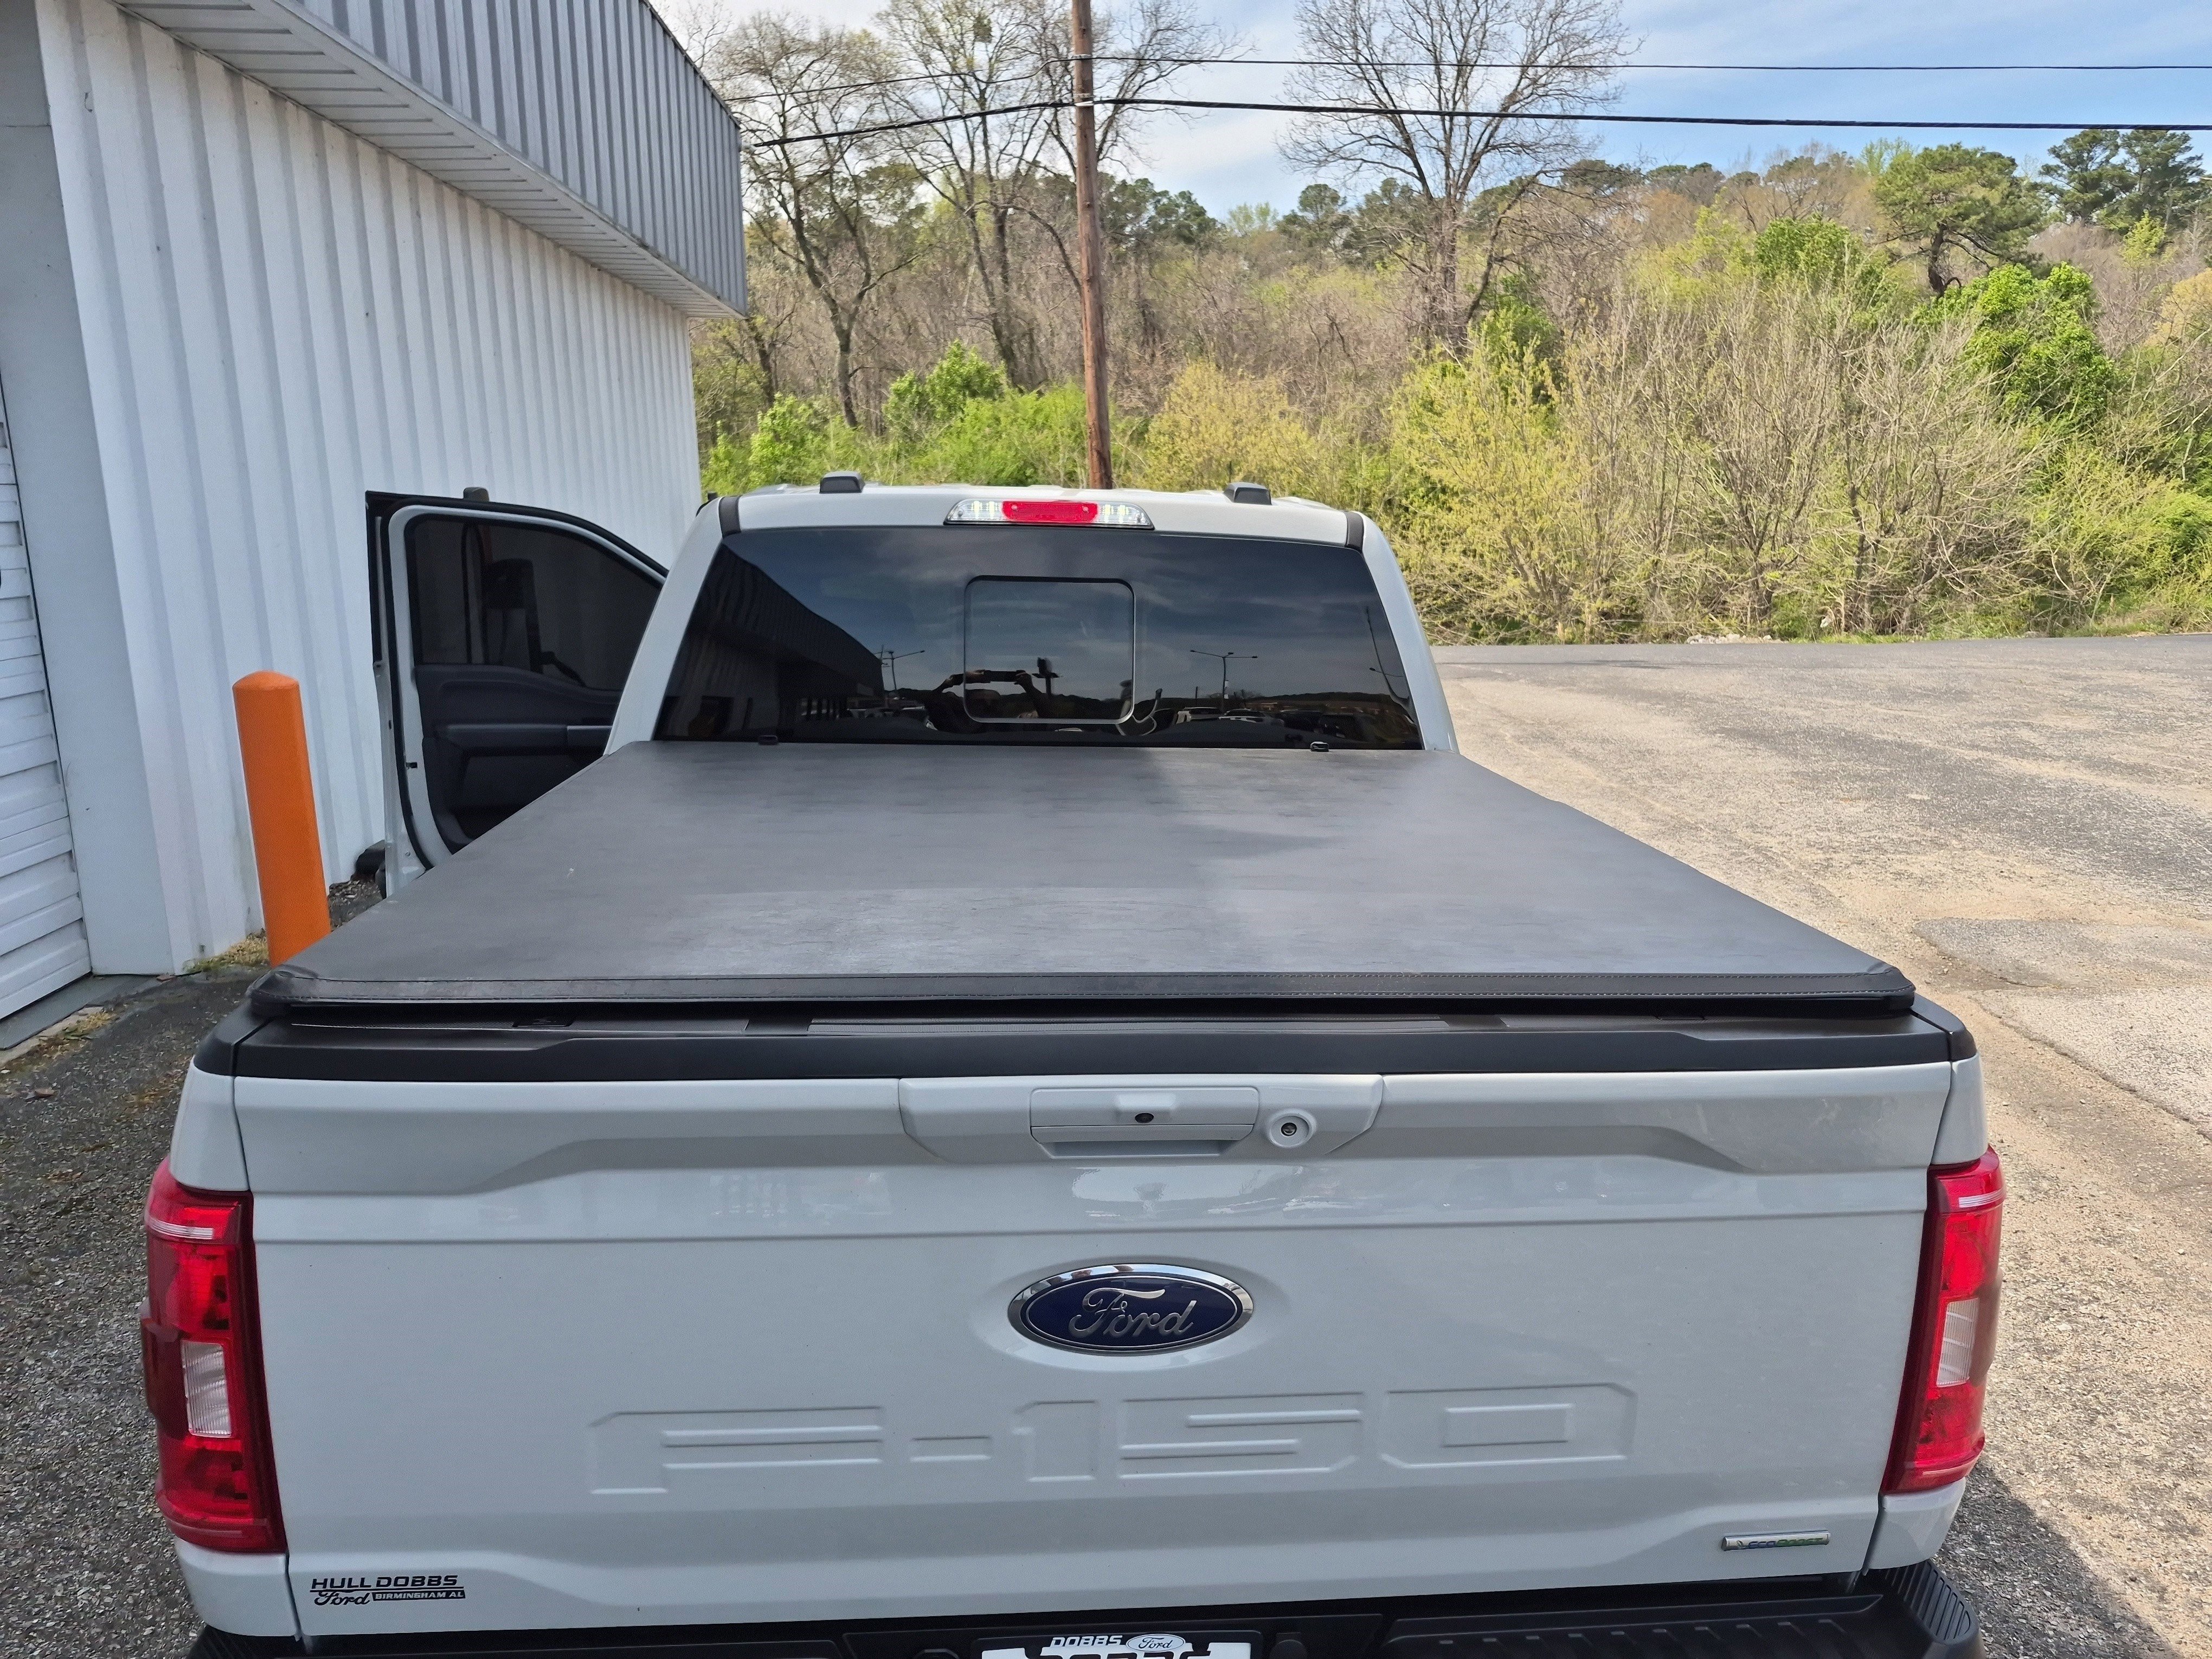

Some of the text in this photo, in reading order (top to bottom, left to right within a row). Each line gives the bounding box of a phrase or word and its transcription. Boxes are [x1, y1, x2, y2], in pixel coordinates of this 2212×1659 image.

[1068, 1287, 1197, 1338] Ford
[589, 1382, 1638, 1494] F-150
[311, 1575, 458, 1589] HULL DOBBS
[314, 1591, 371, 1606] Ford
[1051, 1635, 1173, 1649] DOBBS Ford
